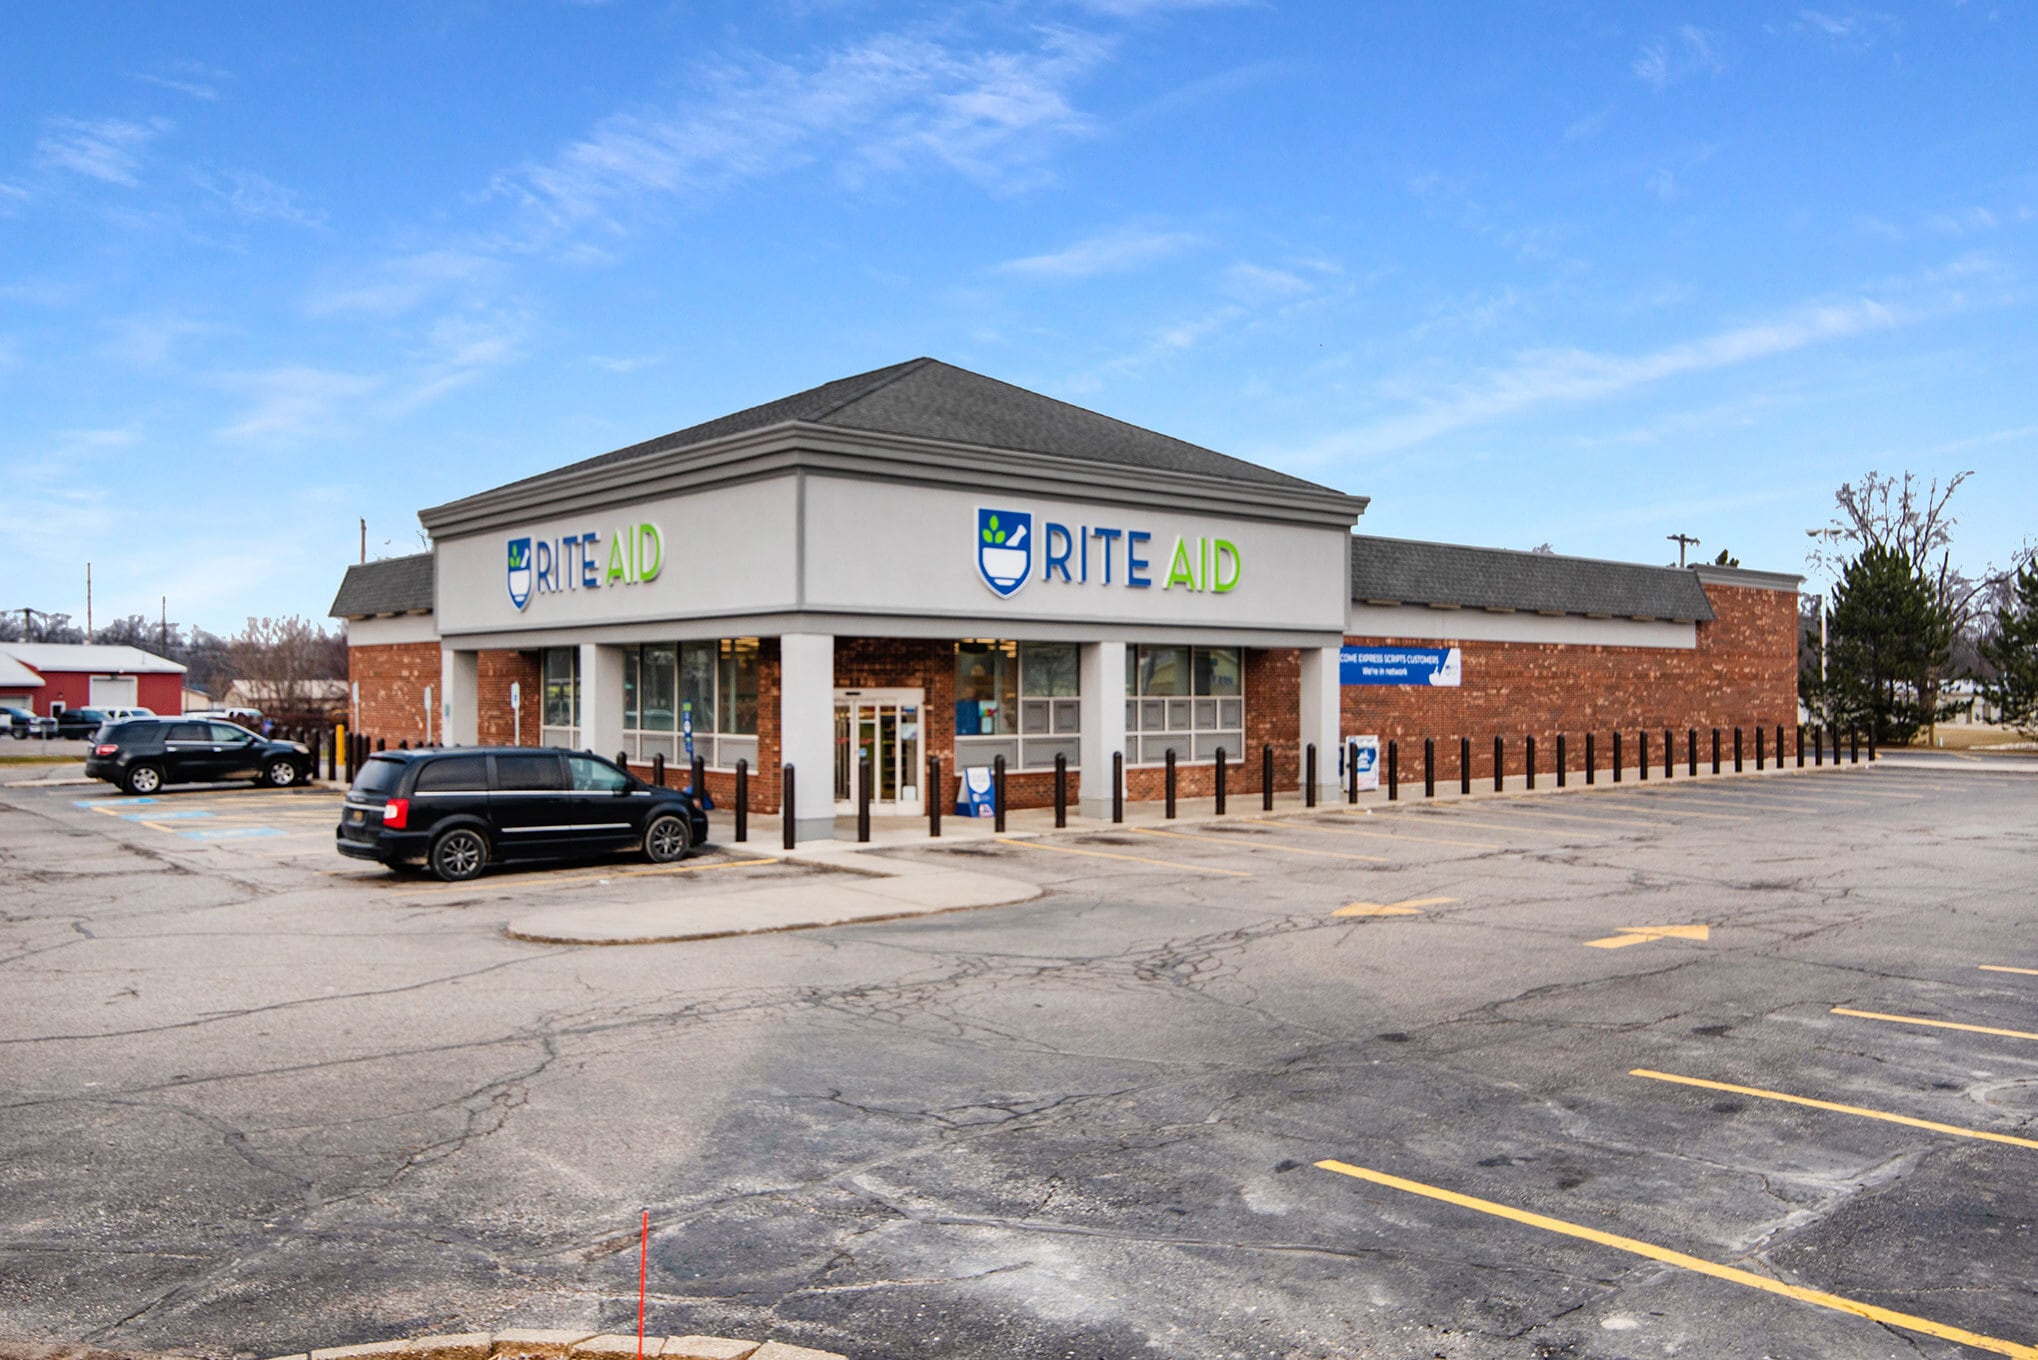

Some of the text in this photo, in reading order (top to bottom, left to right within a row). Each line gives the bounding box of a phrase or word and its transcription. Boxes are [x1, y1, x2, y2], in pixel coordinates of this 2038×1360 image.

[536, 523, 663, 593] RITE AID
[1043, 522, 1241, 593] RITE AID
[1358, 653, 1383, 663] EXPRESS
[1384, 654, 1406, 664] SCRIPTS
[1407, 655, 1439, 664] CUSTOMERS
[1385, 667, 1408, 676] network
